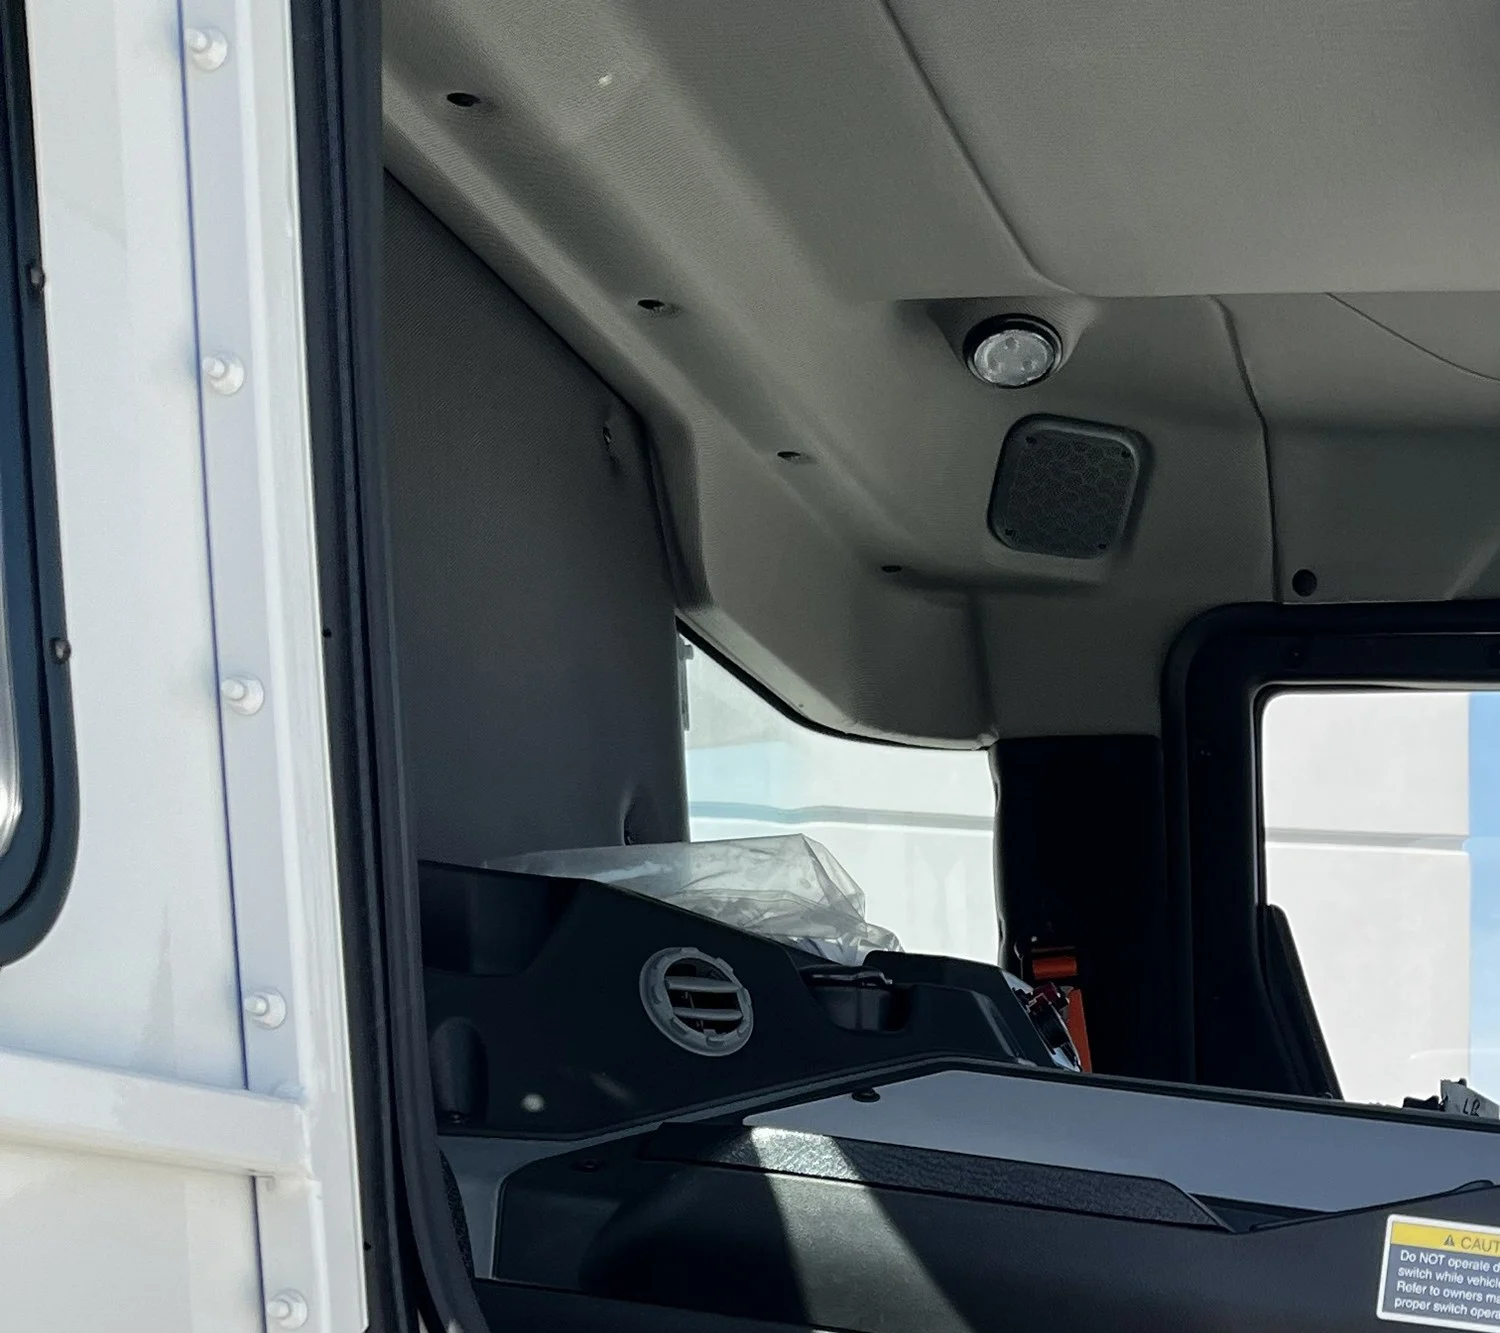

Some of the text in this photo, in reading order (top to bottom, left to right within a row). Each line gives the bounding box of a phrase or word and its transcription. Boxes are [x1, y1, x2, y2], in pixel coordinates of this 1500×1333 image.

[1400, 1250, 1416, 1262] Do
[1419, 1252, 1445, 1265] NOT
[1448, 1258, 1490, 1271] operate
[1398, 1267, 1432, 1279] switch
[1435, 1272, 1464, 1284] while
[1397, 1280, 1427, 1294] Refer
[1429, 1285, 1440, 1296] to
[1443, 1288, 1483, 1302] owners
[1395, 1297, 1431, 1311] proper
[1433, 1302, 1468, 1315] switch
